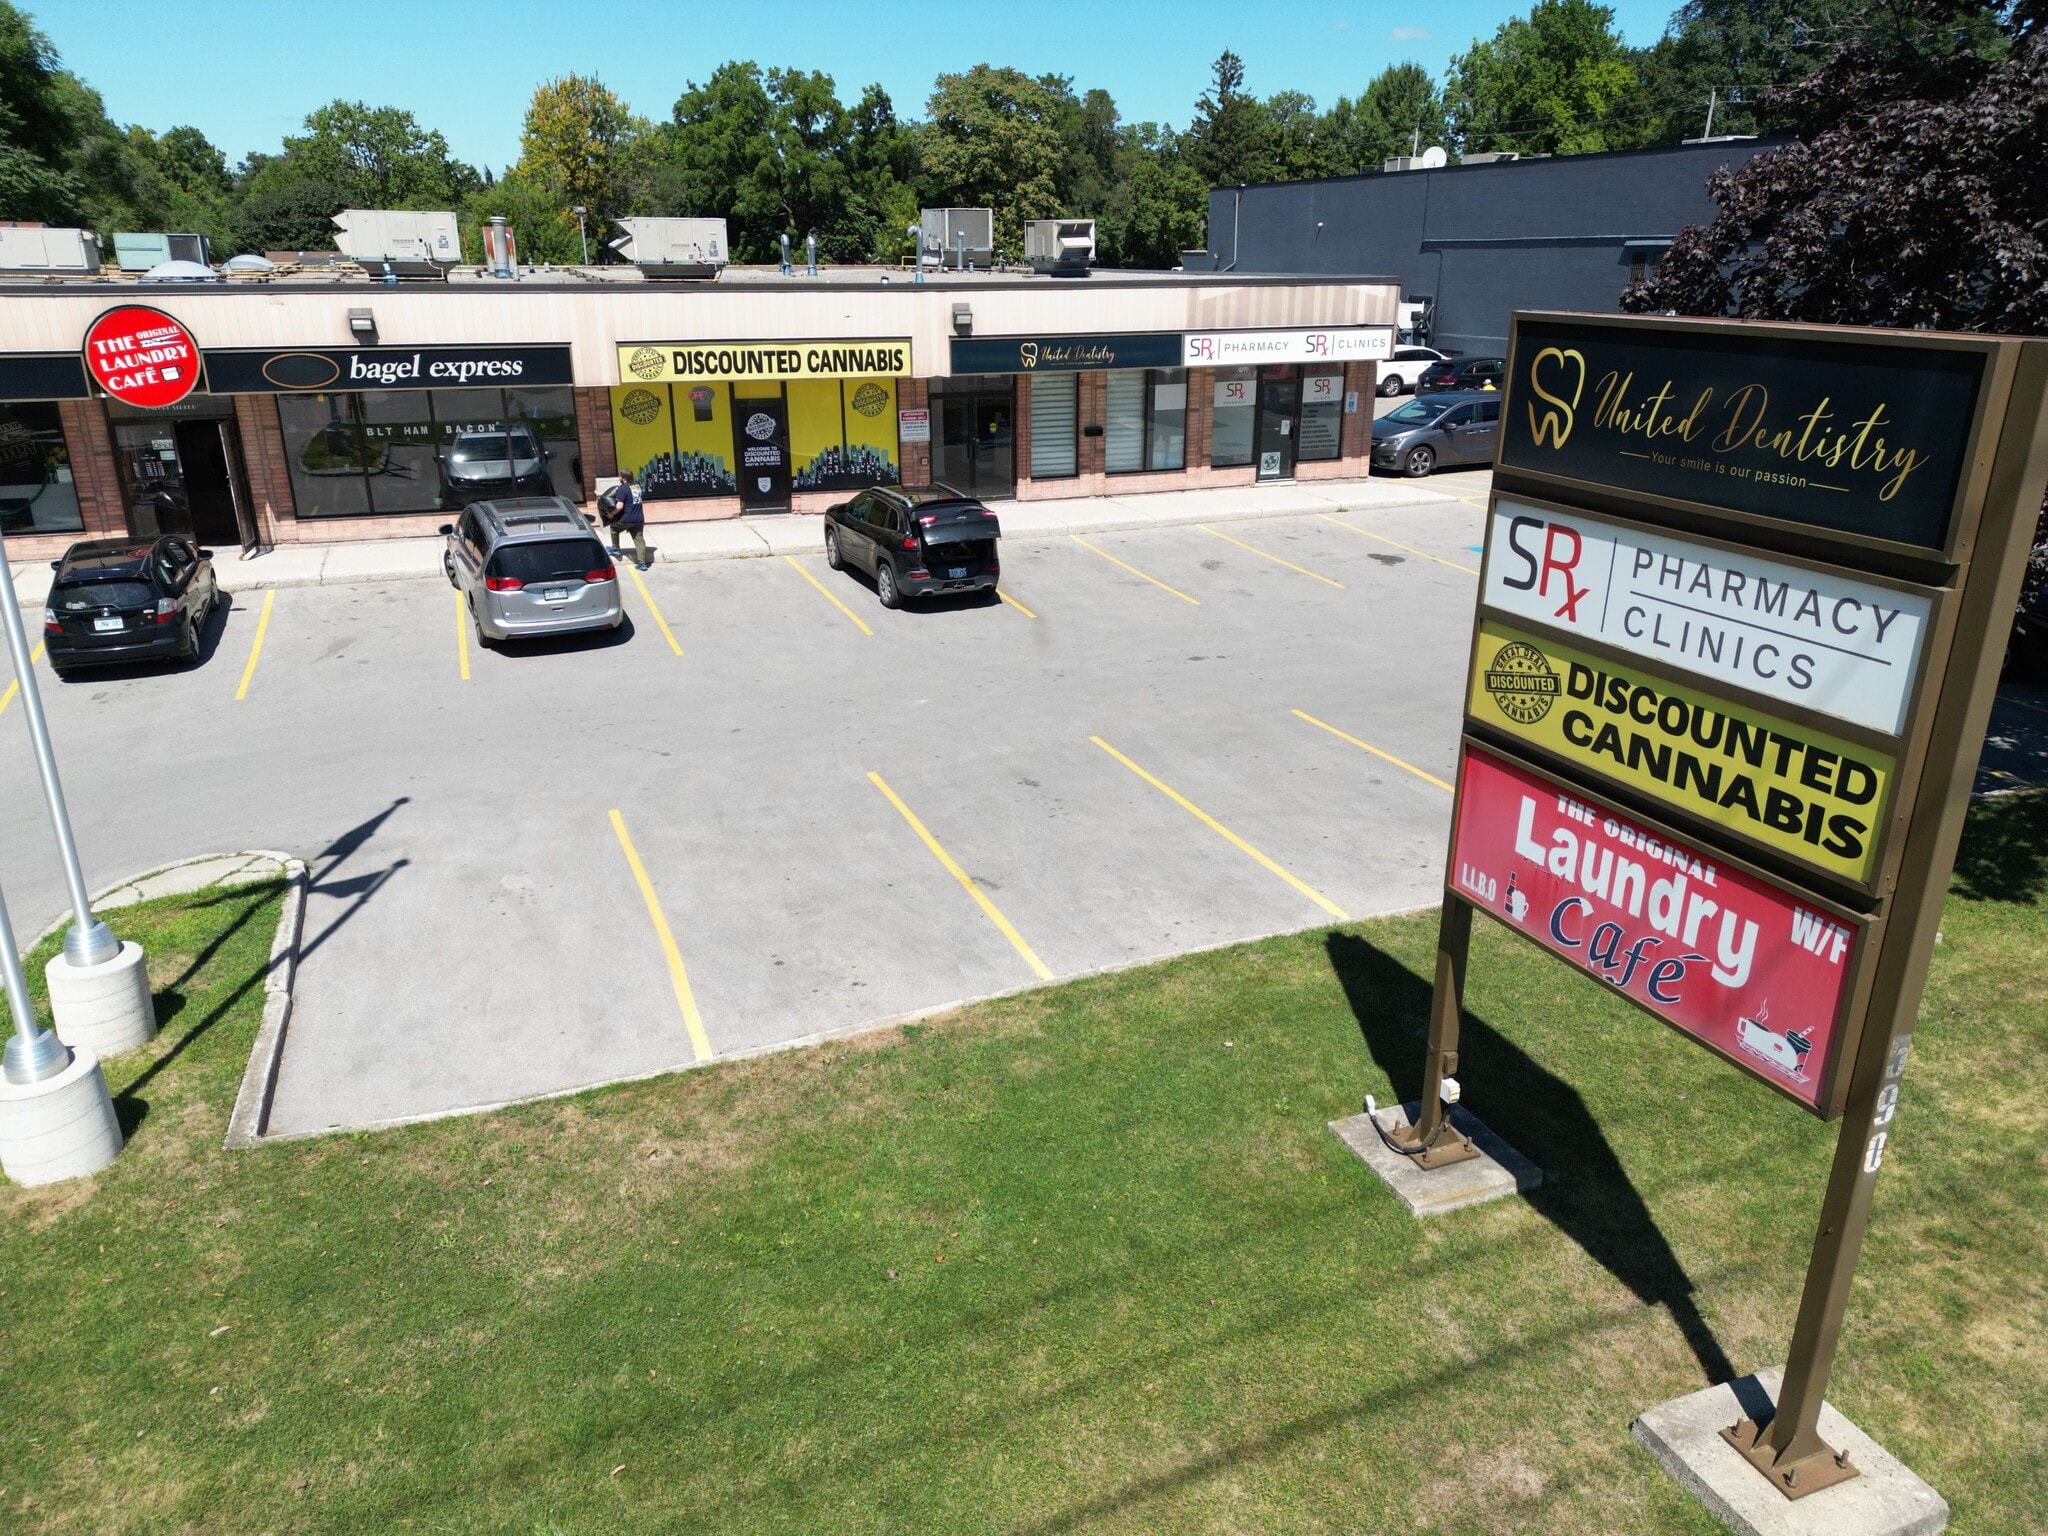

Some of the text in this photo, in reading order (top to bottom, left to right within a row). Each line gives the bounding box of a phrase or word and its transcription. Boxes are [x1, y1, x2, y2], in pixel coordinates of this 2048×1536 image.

[93, 336, 136, 354] THE
[136, 326, 179, 339] ORIGINAL
[1338, 338, 1387, 349] CLINICS
[100, 345, 188, 372] LAUNDRY
[1041, 344, 1116, 364] United Dentistry
[1224, 341, 1290, 352] PHARMACY
[350, 354, 523, 384] bagel express
[673, 349, 904, 375] DISCOUNTED CANNABIS
[624, 399, 659, 415] DISCOUNTED
[366, 424, 495, 436] BLT HAM BACON
[1594, 370, 1930, 501] United Dentistry
[1651, 451, 1806, 488] Your smile is our passion
[1632, 548, 1900, 644] PHARMACY
[1496, 647, 1545, 670] GREAT DEAL
[1624, 605, 1816, 690] CLINICS
[1490, 675, 1555, 692] DISCOUNTED
[1499, 695, 1549, 720] CANNABIS
[1567, 661, 1878, 806] DISCOUNTED
[1562, 710, 1868, 860] CANNABIS
[1557, 794, 1717, 888] THE ORIGINAL
[1515, 795, 1759, 988] Laundry
[1549, 896, 1713, 1004] Café
